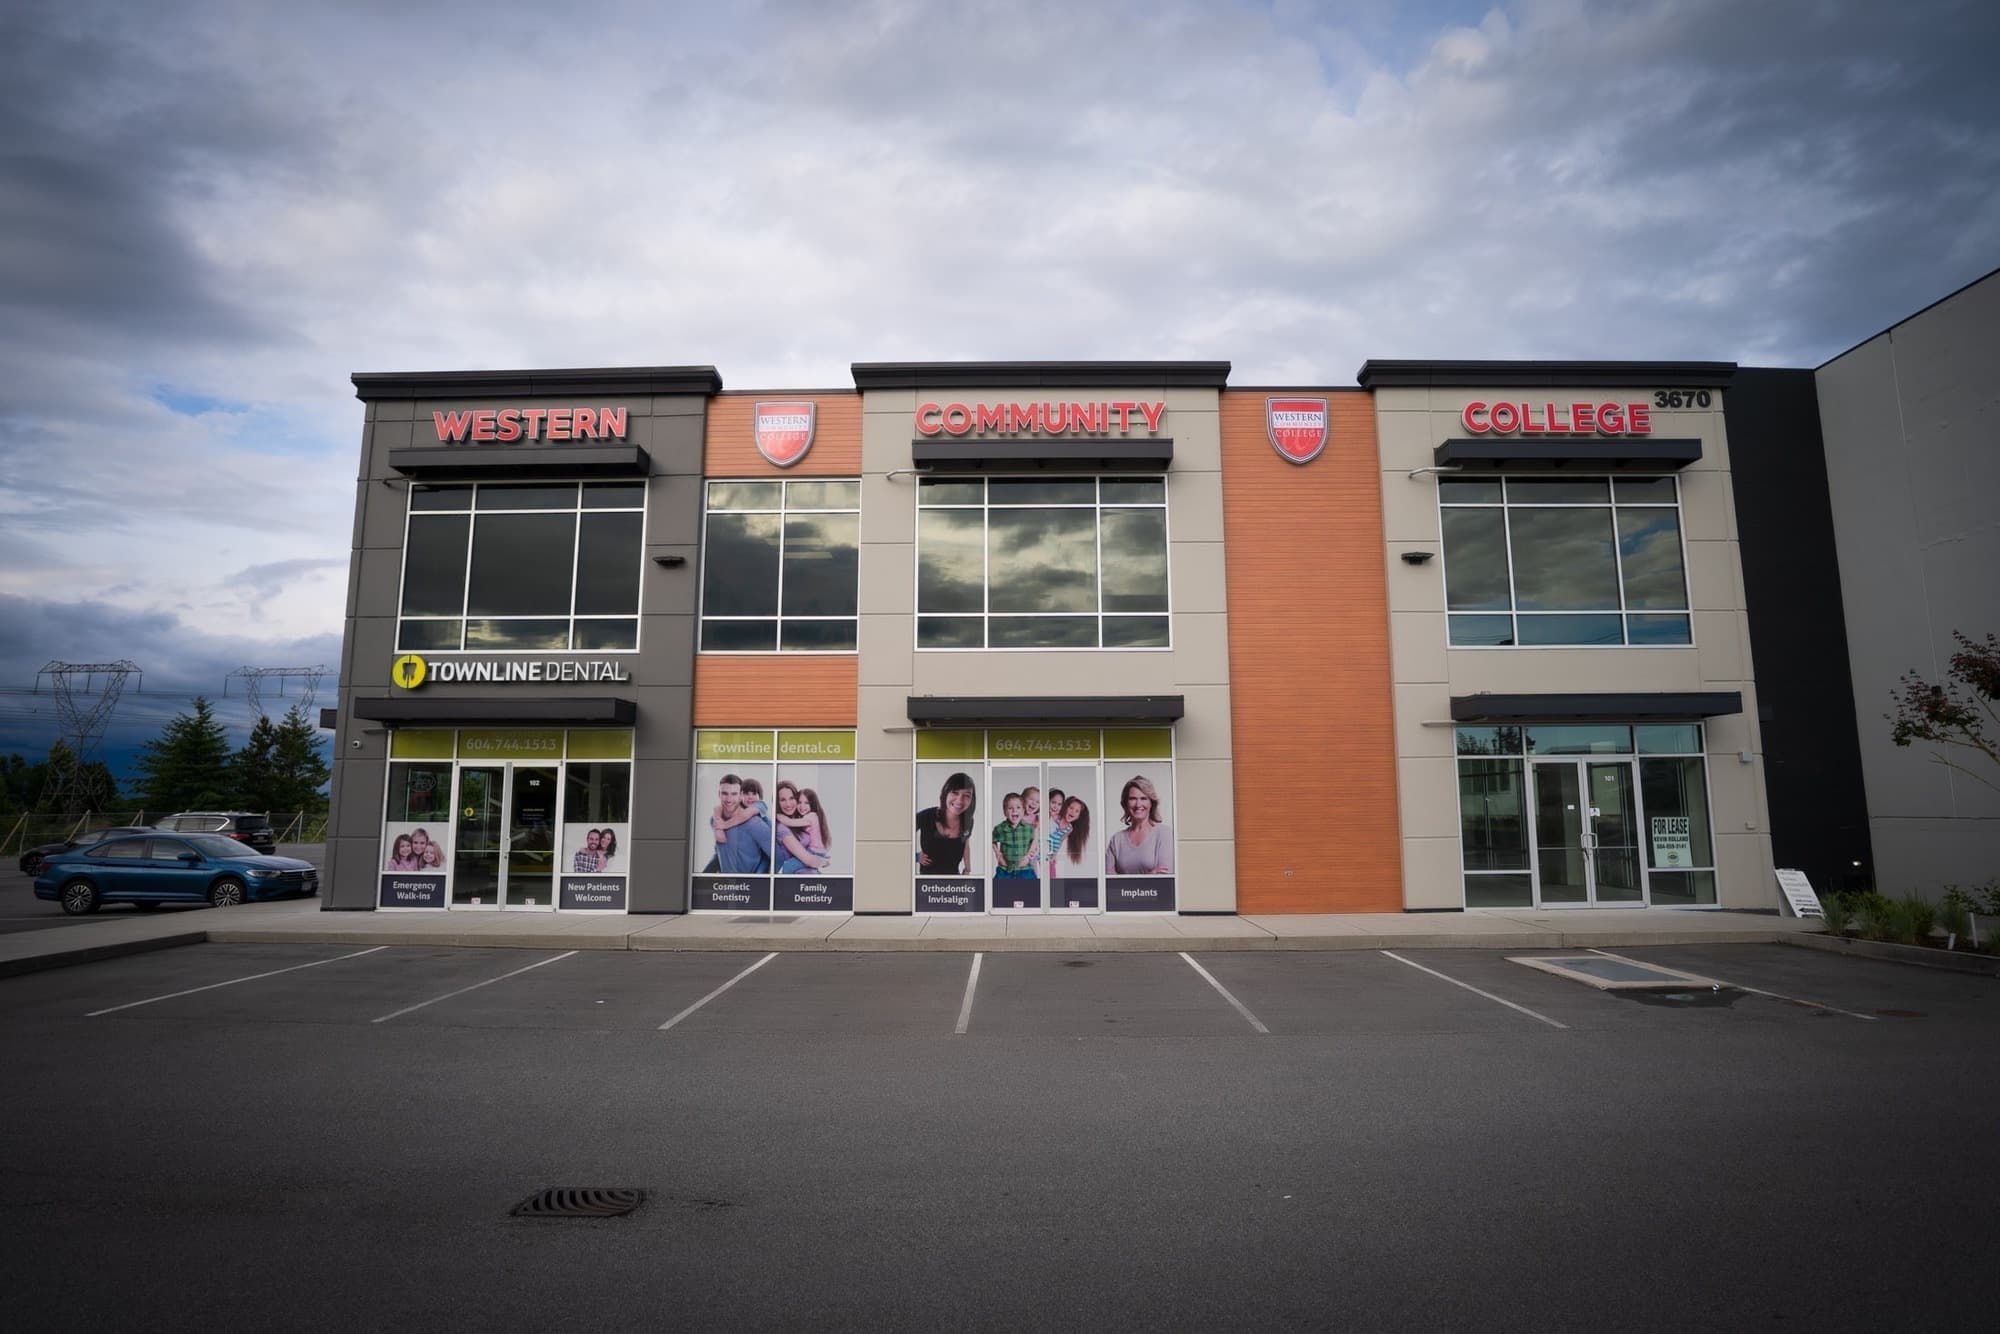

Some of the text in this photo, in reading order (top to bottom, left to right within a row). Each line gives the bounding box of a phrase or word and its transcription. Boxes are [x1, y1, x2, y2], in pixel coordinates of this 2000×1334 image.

[1654, 390, 1712, 409] 3670
[760, 416, 808, 425] WESTERN
[915, 401, 1167, 436] COMMUNITY
[1274, 413, 1322, 421] WESTERN
[1462, 401, 1652, 435] COLLEGE
[432, 406, 628, 442] WESTERN
[1275, 430, 1322, 438] COLLEGE
[428, 661, 628, 682] TOWNLINE DENTAL
[466, 738, 557, 751] 604.744.1513
[712, 741, 841, 754] townline dental.ca
[995, 738, 1092, 752] 604.744.1513
[1653, 818, 1688, 835] FOR LEASE
[392, 881, 437, 892] Emergency
[568, 883, 620, 892] New Patients
[712, 882, 750, 891] Cosmetic
[800, 883, 828, 894] Family
[921, 884, 976, 894] Orthodontics
[396, 891, 431, 901] Walk-ins
[575, 893, 612, 902] Welcome
[712, 893, 750, 903] Dentistry
[1121, 888, 1158, 898] Implants
[794, 894, 833, 904] Dentistry
[928, 895, 969, 905] Invisalign
